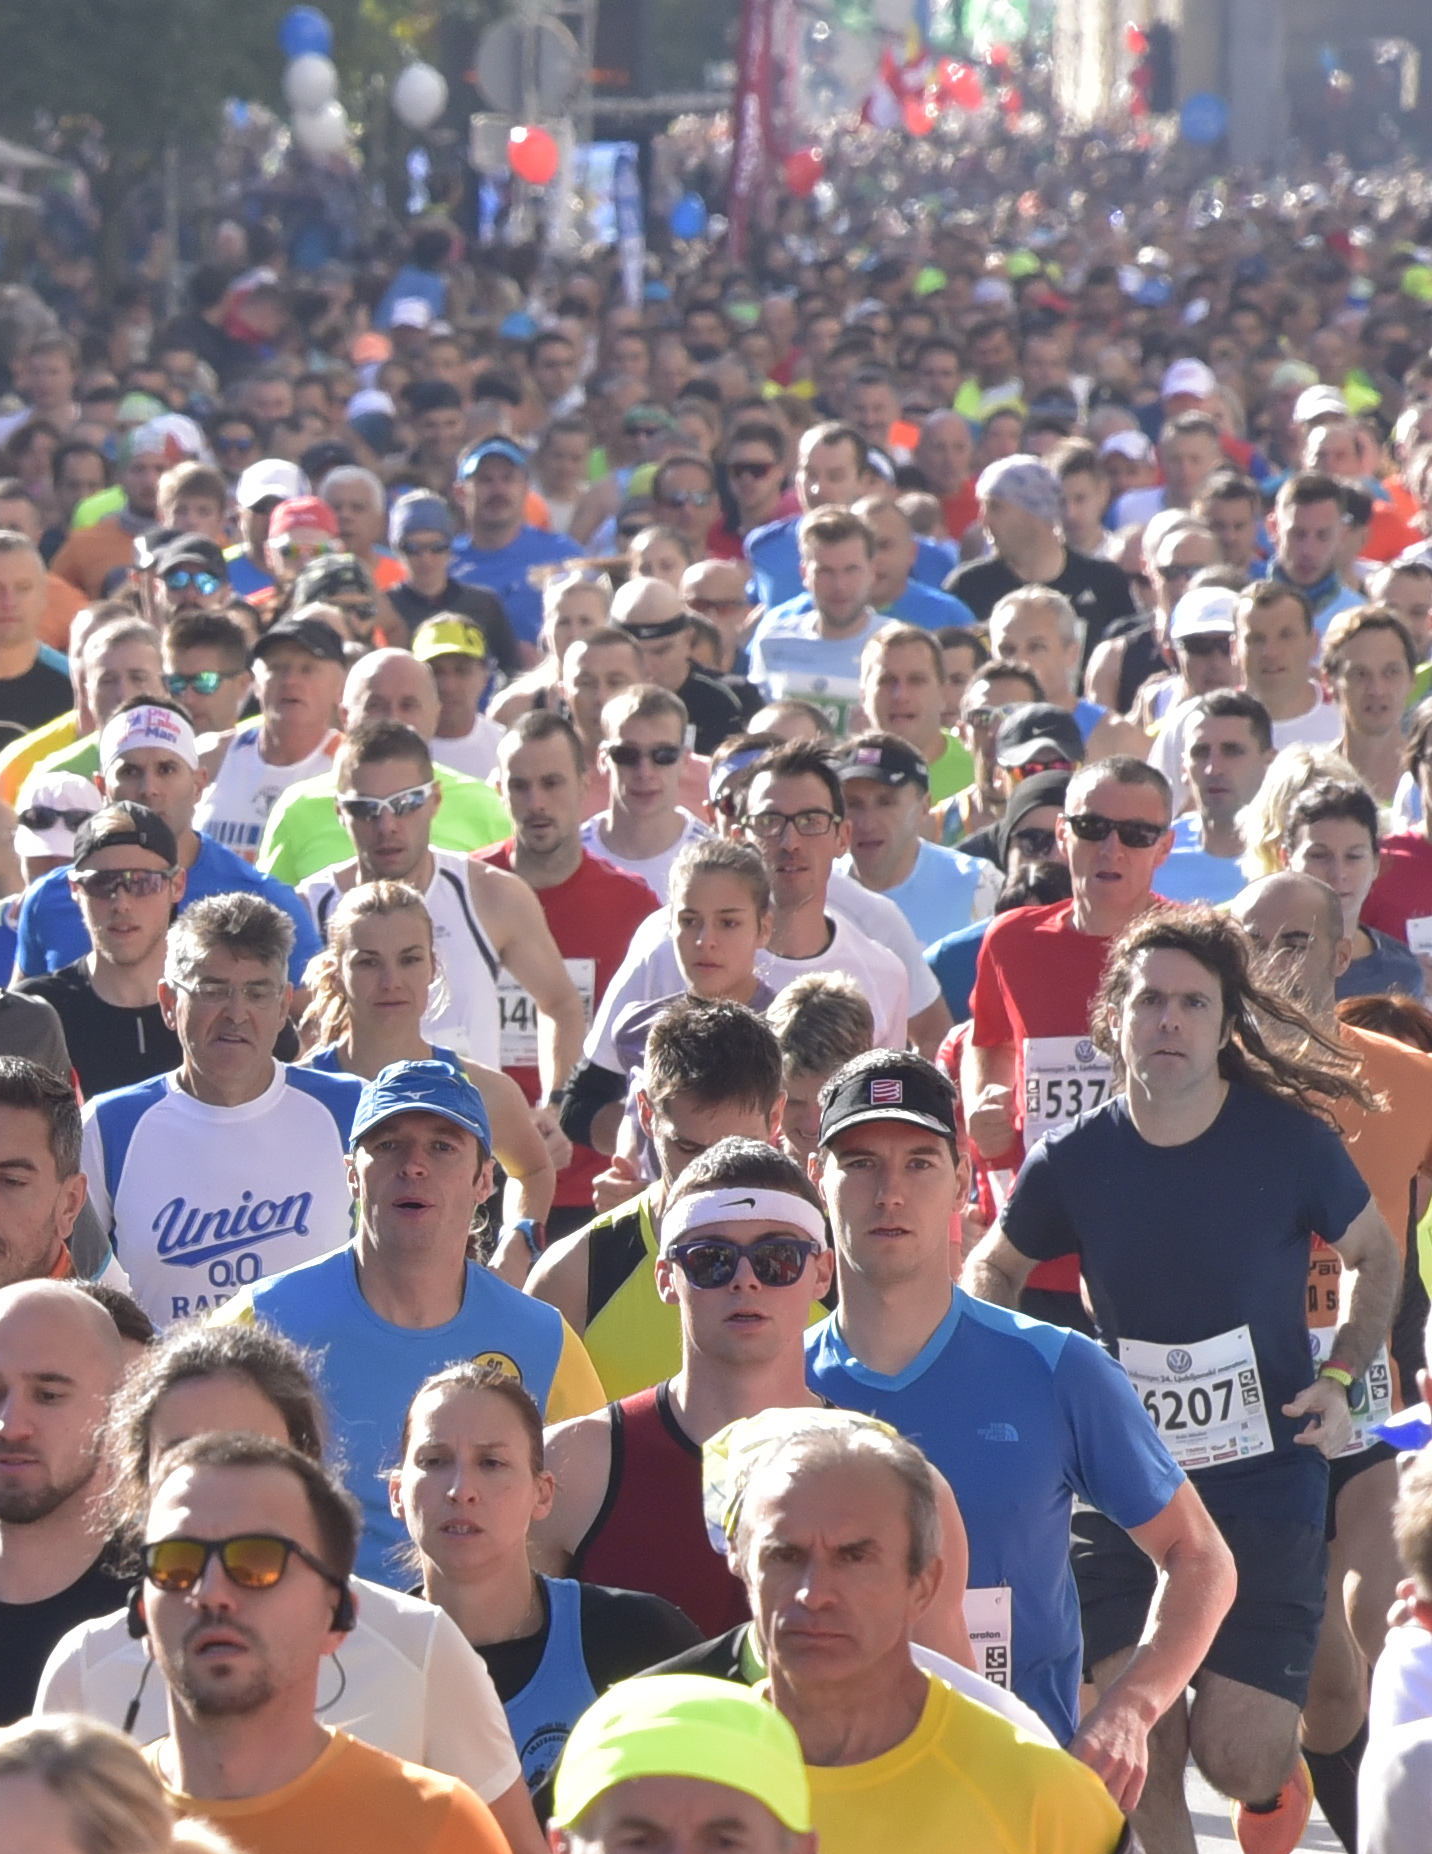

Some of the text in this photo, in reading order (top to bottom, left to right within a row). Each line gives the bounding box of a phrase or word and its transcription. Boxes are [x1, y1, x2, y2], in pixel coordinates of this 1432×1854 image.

[1045, 1079, 1111, 1119] 537
[153, 1190, 312, 1258] Union
[1135, 1379, 1234, 1431] 6207
[969, 1630, 1001, 1641] araton
